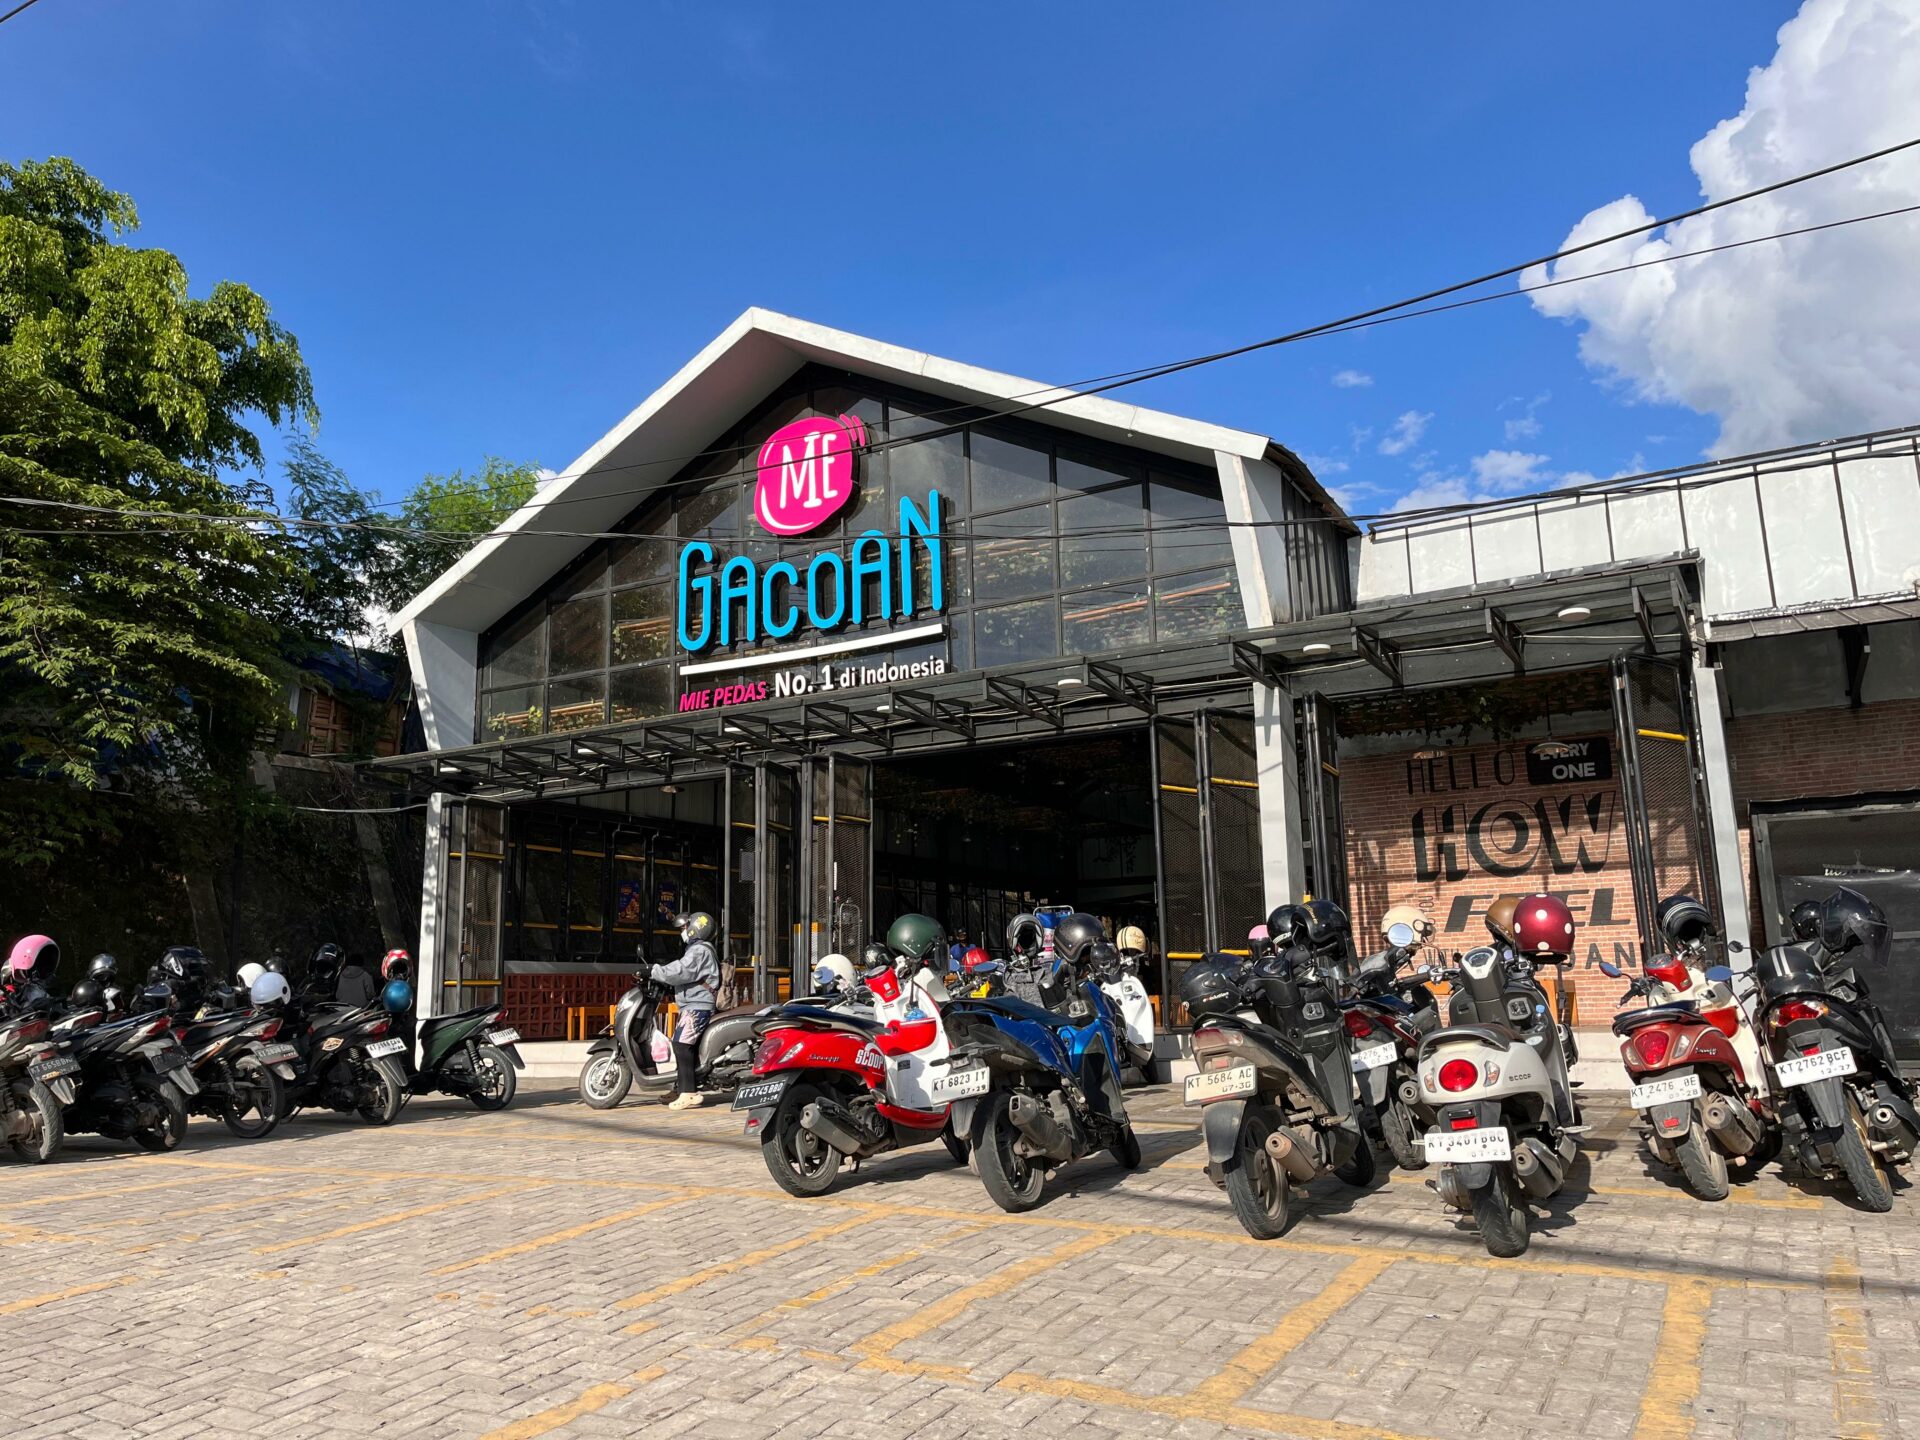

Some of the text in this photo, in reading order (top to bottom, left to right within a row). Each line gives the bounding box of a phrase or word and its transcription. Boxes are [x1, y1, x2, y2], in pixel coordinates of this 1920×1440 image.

[678, 489, 942, 651] GACOAN
[679, 655, 945, 712] MIE PEDAS No. 1 di Indonesia
[1407, 750, 1516, 795] HELLO
[1552, 762, 1596, 780] ONE
[1412, 791, 1616, 882] HOW
[1444, 886, 1631, 932] FEL
[1779, 1050, 1848, 1074] KT 2762 BCF
[934, 1070, 986, 1091] KT 6823 IY
[1187, 1068, 1252, 1089] KT 5684 AC
[1631, 1087, 1643, 1097] KT
[1649, 1082, 1674, 1094] 2476
[739, 1089, 750, 1099] KT
[749, 1086, 769, 1097] 2745
